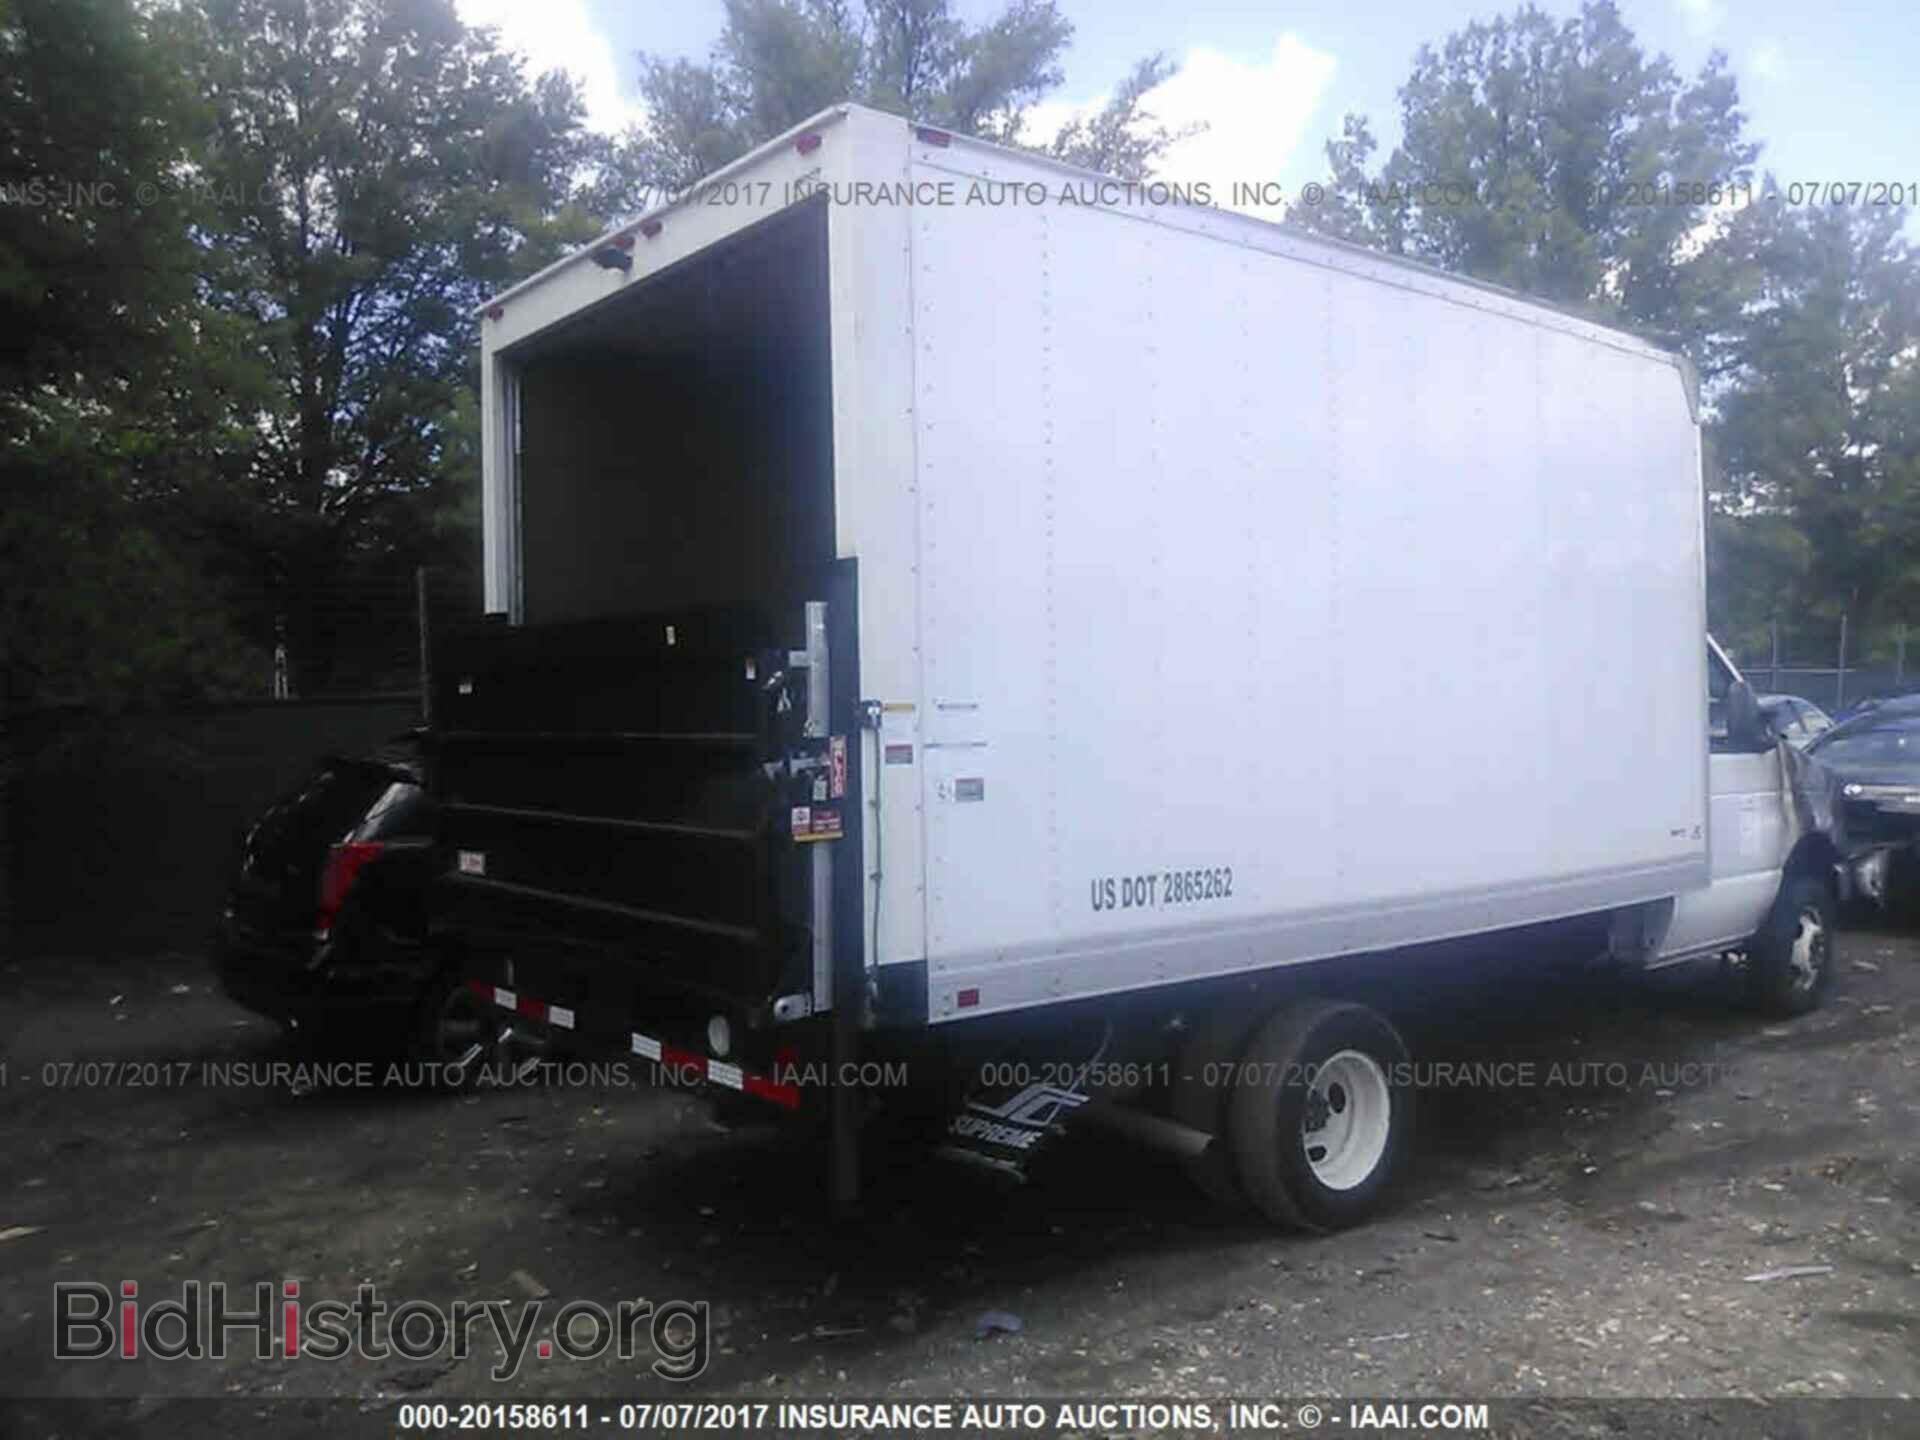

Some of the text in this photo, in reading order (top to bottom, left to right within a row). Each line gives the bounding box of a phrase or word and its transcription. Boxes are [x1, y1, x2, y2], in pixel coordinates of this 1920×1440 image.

[1091, 867, 1233, 911] US DOT 2865262
